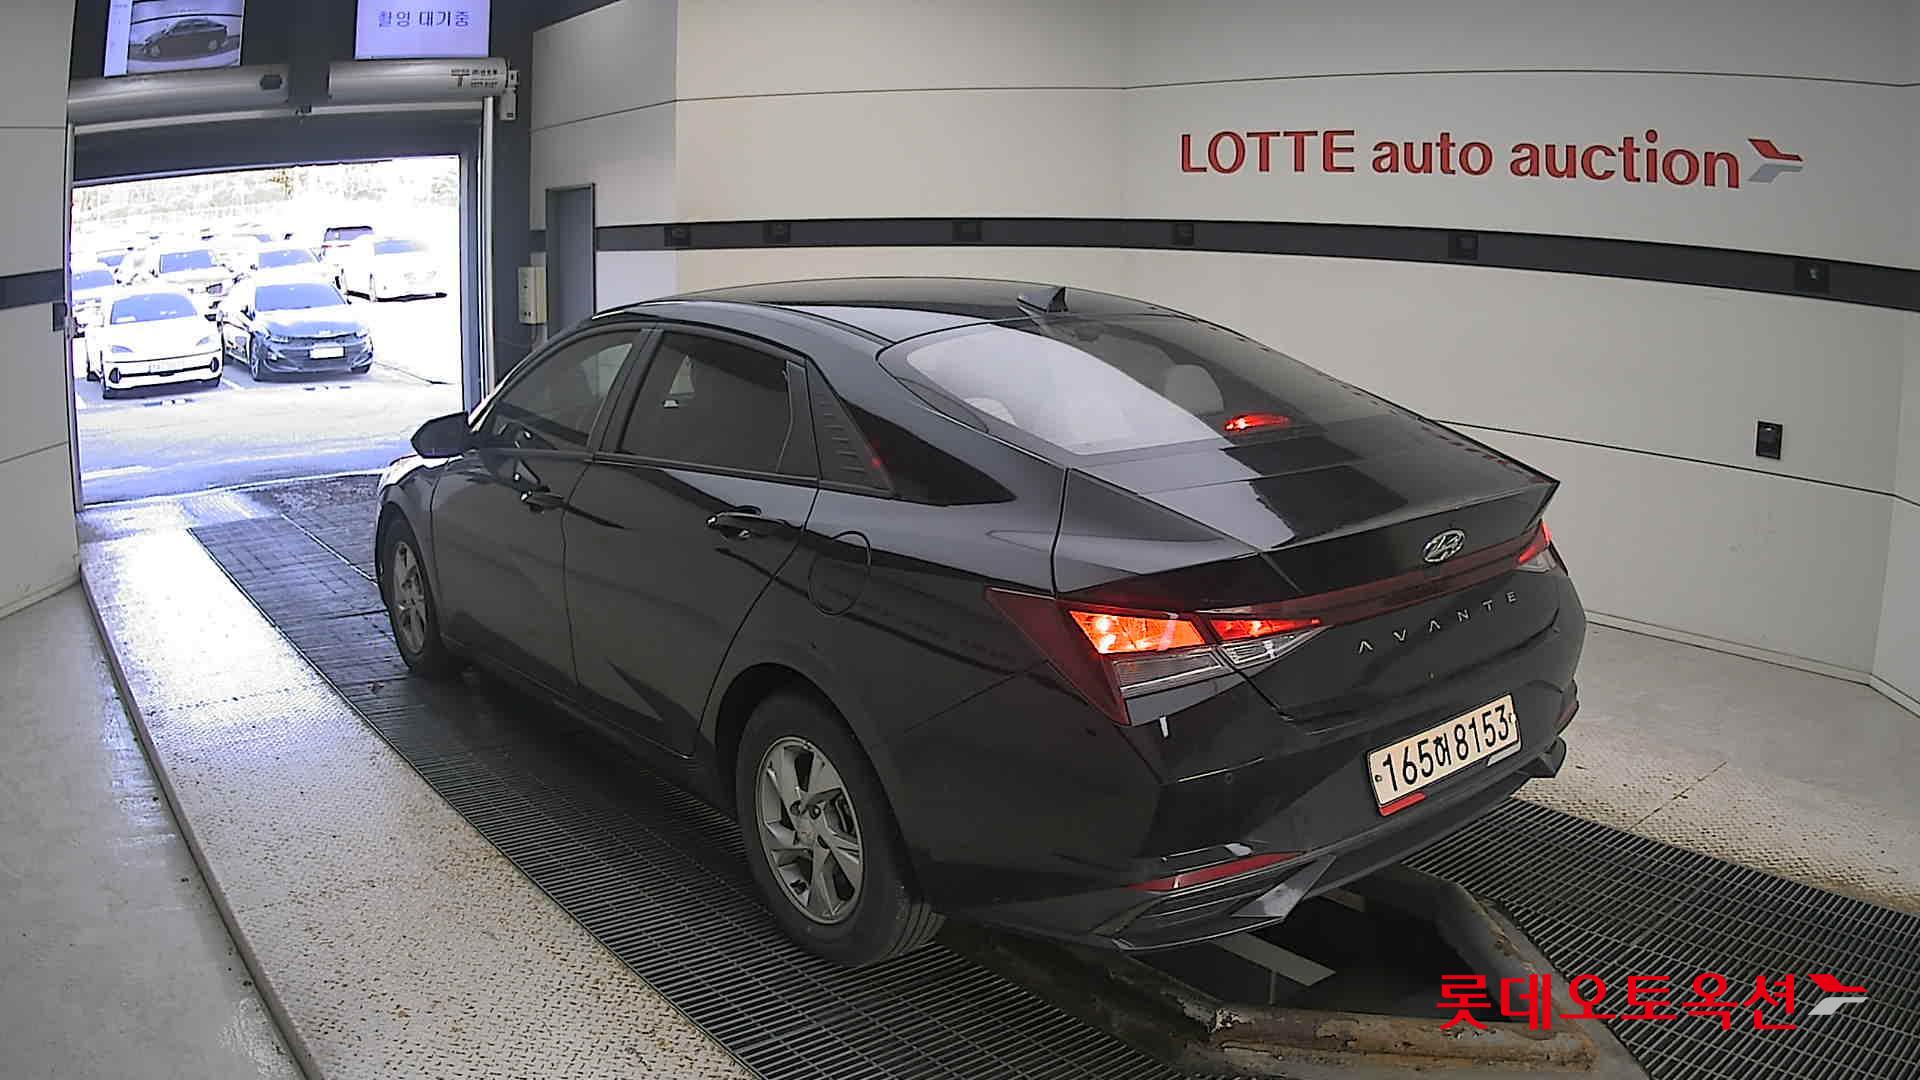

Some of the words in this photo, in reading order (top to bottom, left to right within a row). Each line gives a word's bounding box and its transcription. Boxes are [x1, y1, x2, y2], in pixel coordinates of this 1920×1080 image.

[418, 10, 470, 28] 대기중
[1181, 131, 1356, 174] LOTTE
[1372, 133, 1492, 176] auto
[1510, 130, 1740, 188] auction
[1358, 591, 1517, 654] AVANTE
